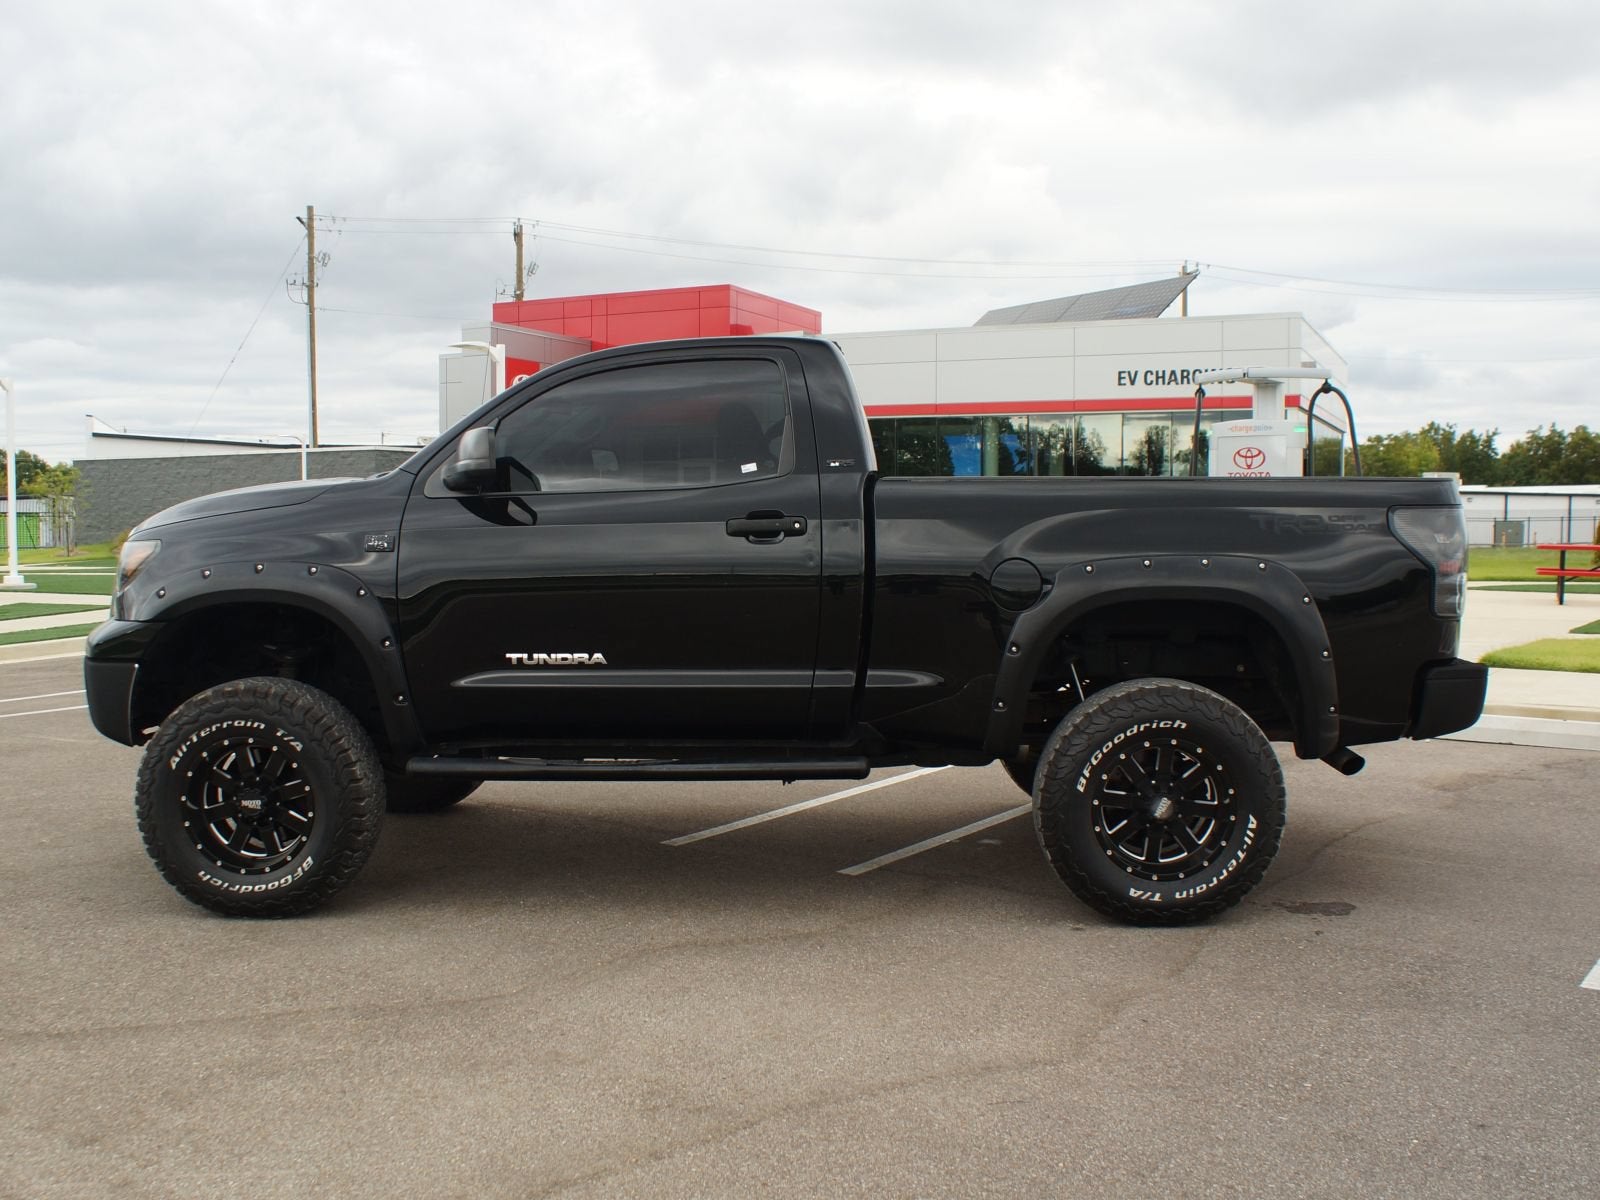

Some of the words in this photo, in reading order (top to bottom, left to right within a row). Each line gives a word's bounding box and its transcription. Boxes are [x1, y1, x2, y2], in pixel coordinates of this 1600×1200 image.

[1117, 370, 1138, 386] EV
[505, 653, 608, 665] TUNDRA
[169, 719, 266, 770] All-Terrain
[274, 728, 304, 752] T/A
[1076, 719, 1188, 793] BFGoodrich
[197, 856, 314, 894] BFGoodrich
[1175, 814, 1257, 899] All-Terrain
[1128, 887, 1162, 902] T/A
